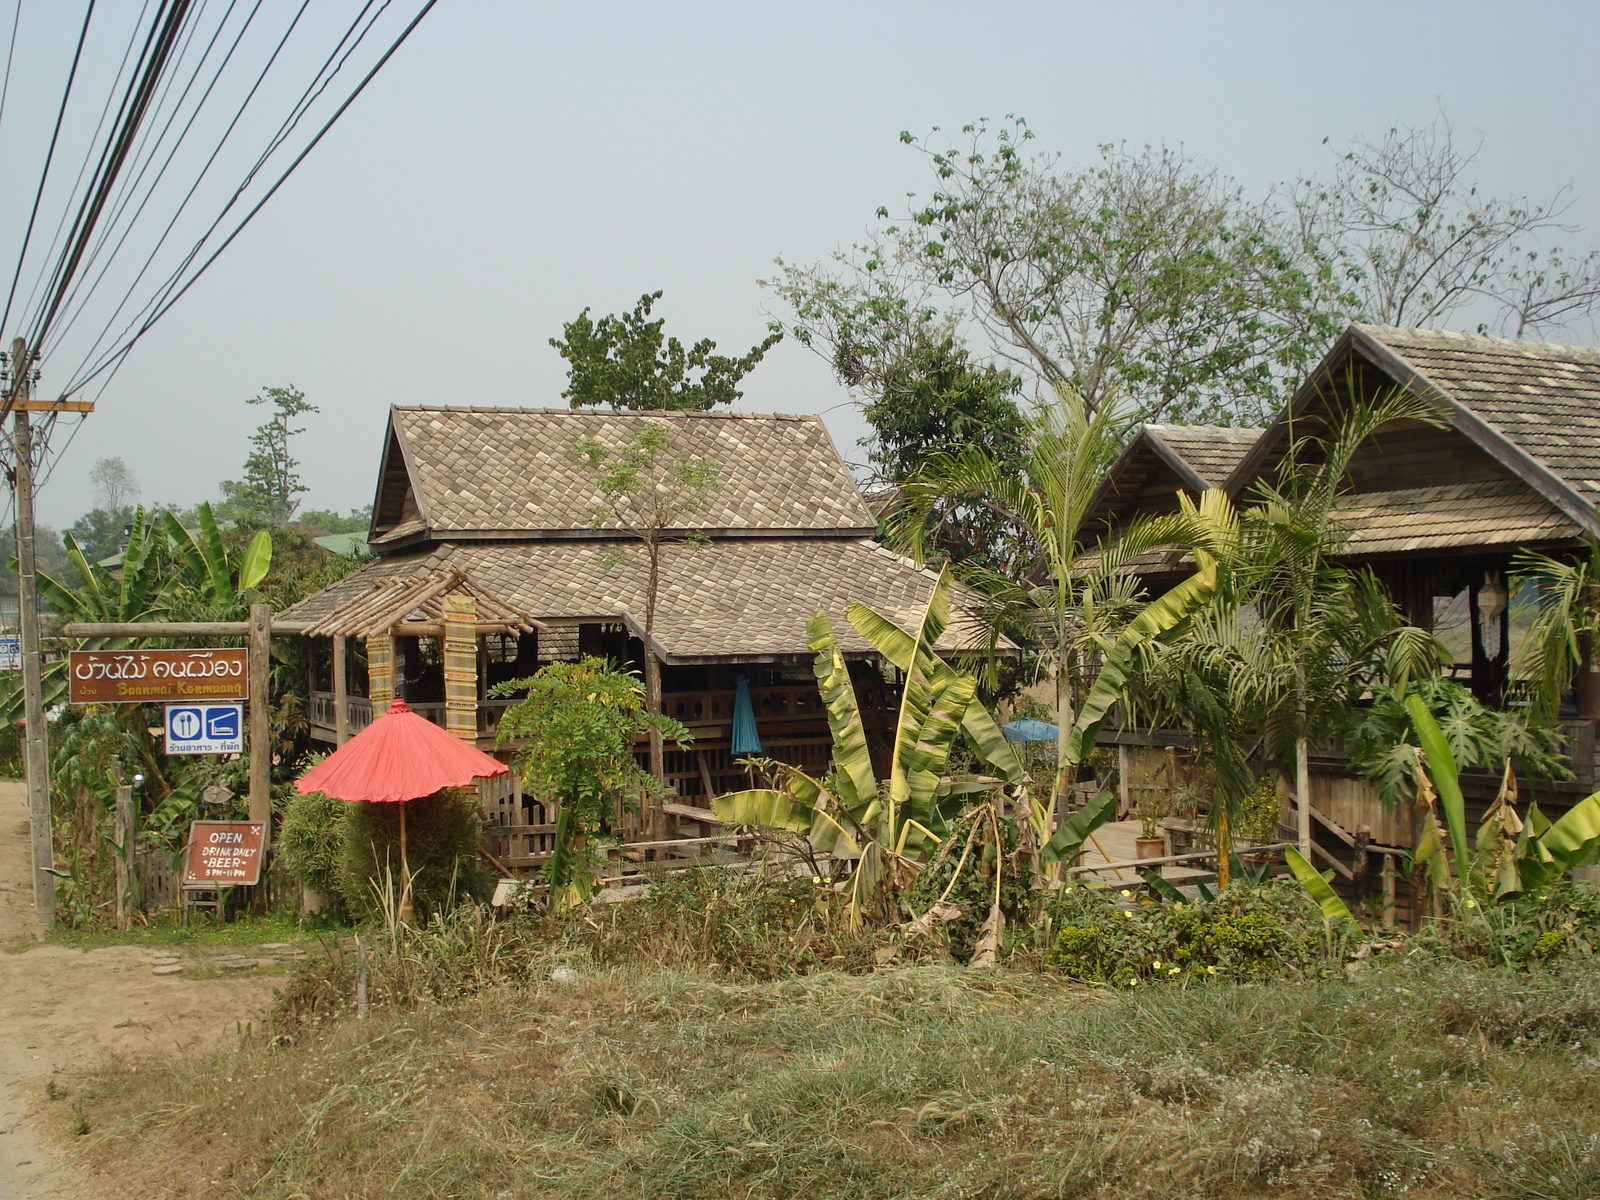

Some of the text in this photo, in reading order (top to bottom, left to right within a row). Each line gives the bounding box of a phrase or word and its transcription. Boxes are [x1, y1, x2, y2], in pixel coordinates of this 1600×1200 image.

[76, 652, 243, 680] บ้านไม้ คนเมือง
[116, 681, 242, 698] Baanmai Konmuang
[169, 743, 213, 752] ร้านอาหาร
[220, 740, 240, 751] ที่พัก
[202, 846, 256, 857] DRINK DAILY
